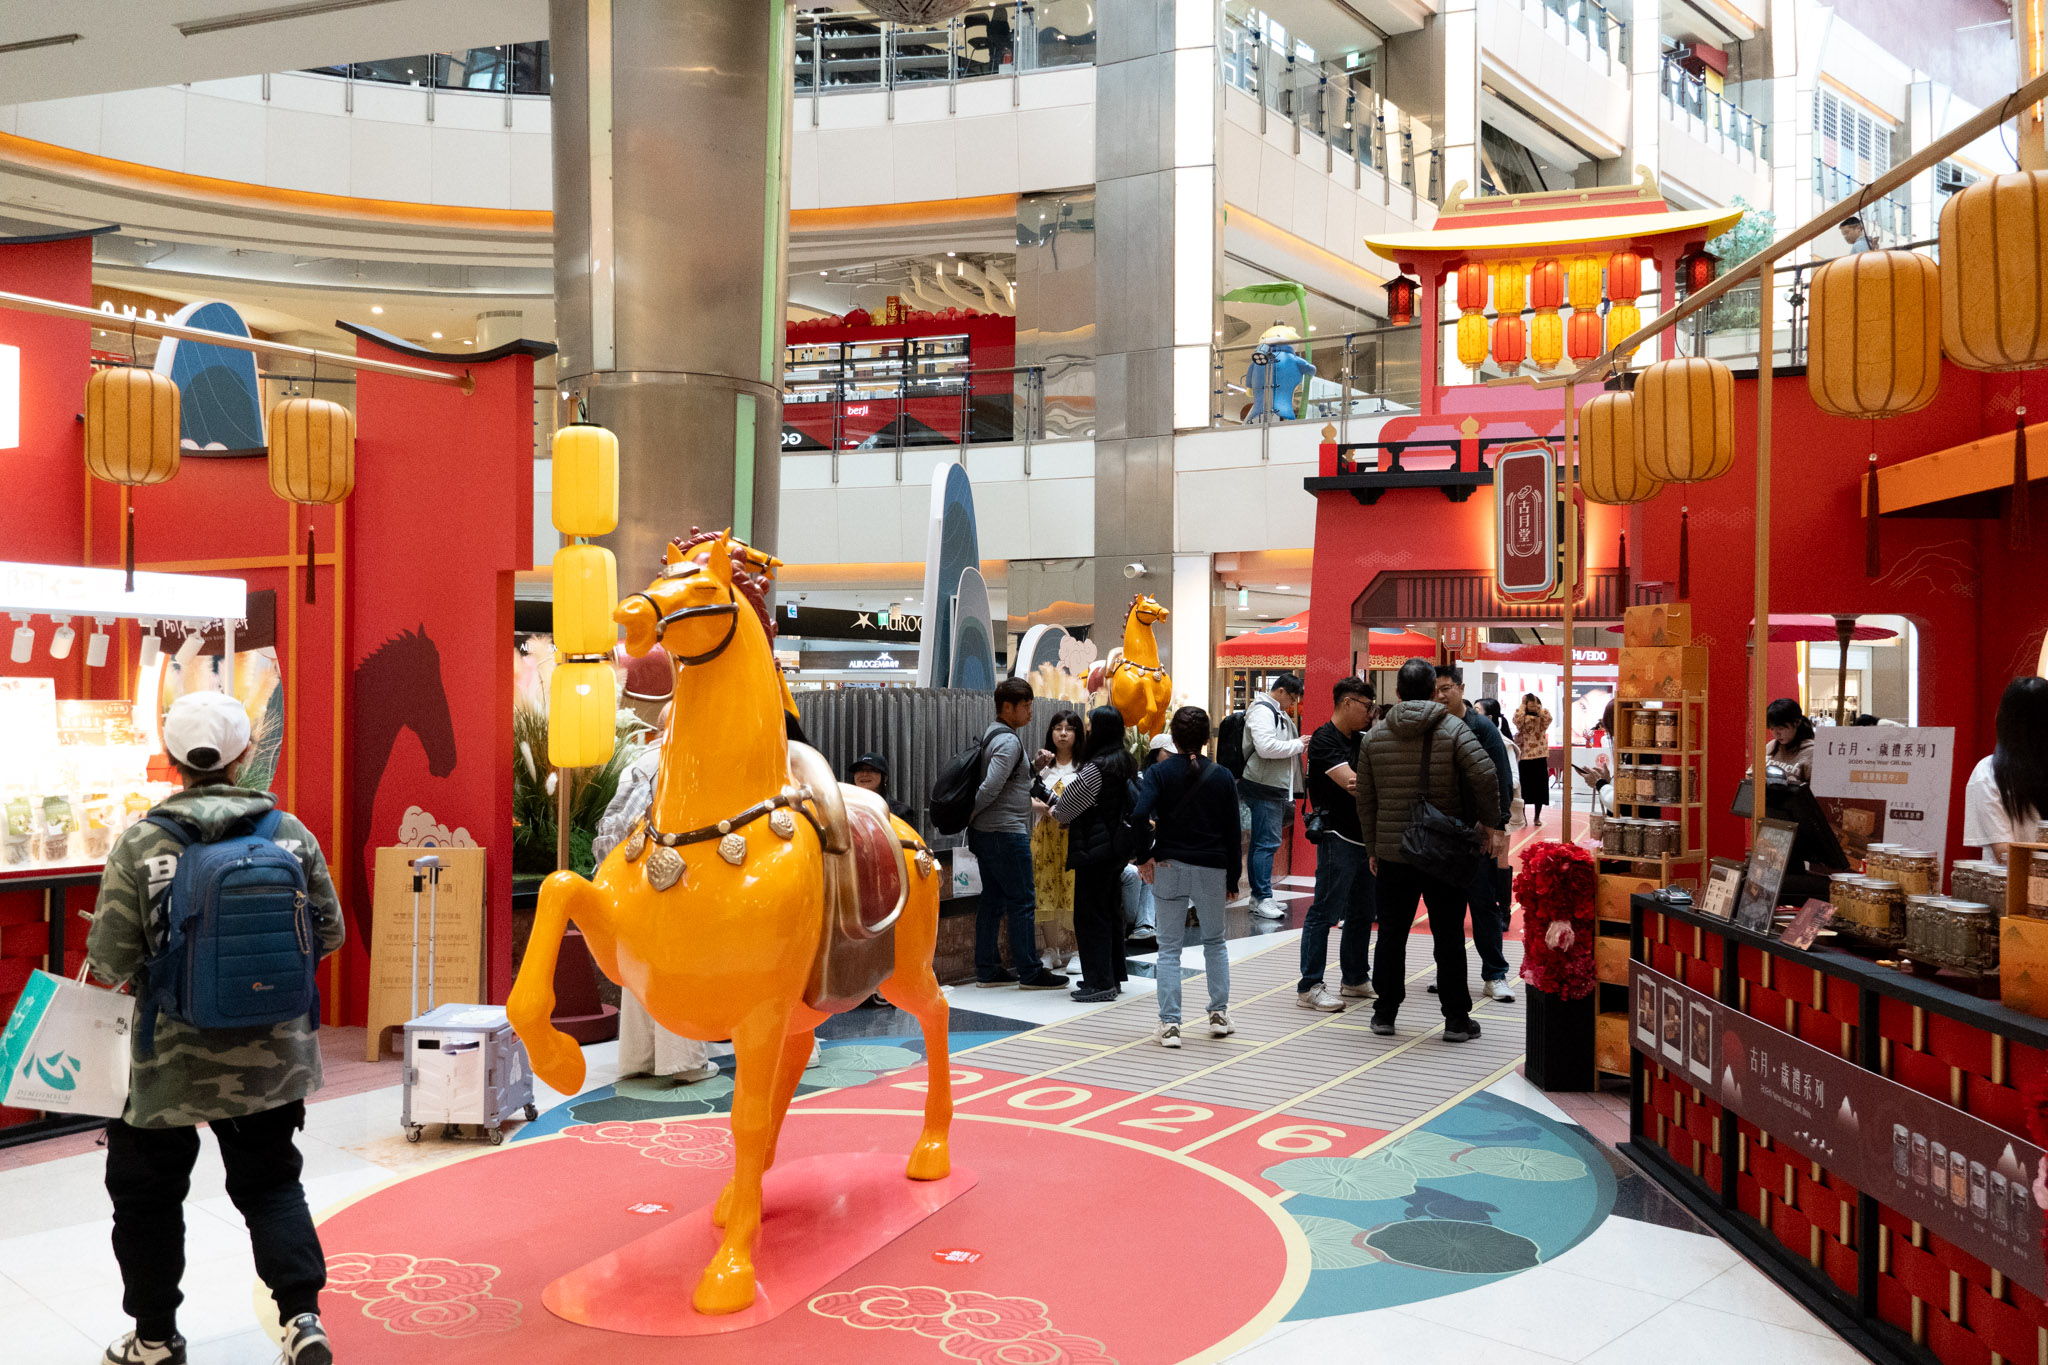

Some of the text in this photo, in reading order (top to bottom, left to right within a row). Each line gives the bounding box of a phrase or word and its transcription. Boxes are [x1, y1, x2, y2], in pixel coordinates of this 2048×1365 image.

[1518, 500, 1531, 542] 古月堂
[1572, 648, 1607, 661] HISEIDO
[298, 1315, 312, 1324] NIKE
